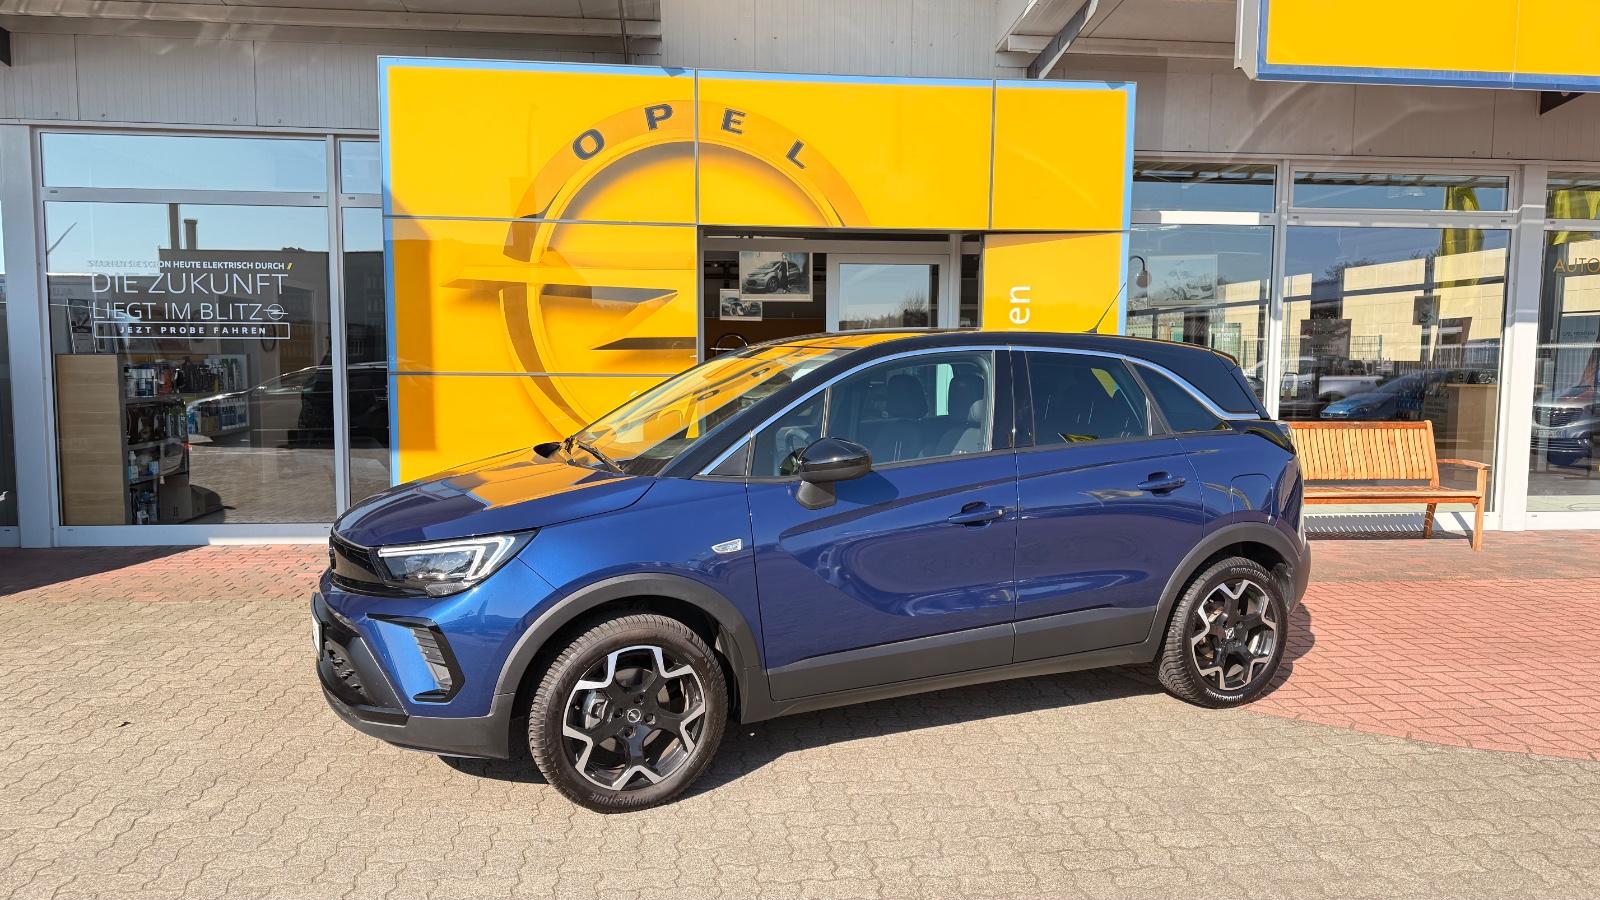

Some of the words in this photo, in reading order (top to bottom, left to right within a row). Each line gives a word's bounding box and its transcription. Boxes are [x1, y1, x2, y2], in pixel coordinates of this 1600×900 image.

[572, 103, 805, 170] OPEL
[173, 261, 200, 269] HEUTE
[255, 262, 285, 270] DURCH
[91, 272, 139, 294] DIE
[148, 272, 288, 294] ZUKUNFT
[92, 302, 156, 320] LIEGT
[164, 302, 190, 320] IM
[200, 303, 263, 320] BLITZ
[119, 326, 152, 334] JEZT
[160, 326, 205, 334] PROBE
[213, 326, 266, 335] FAHREN
